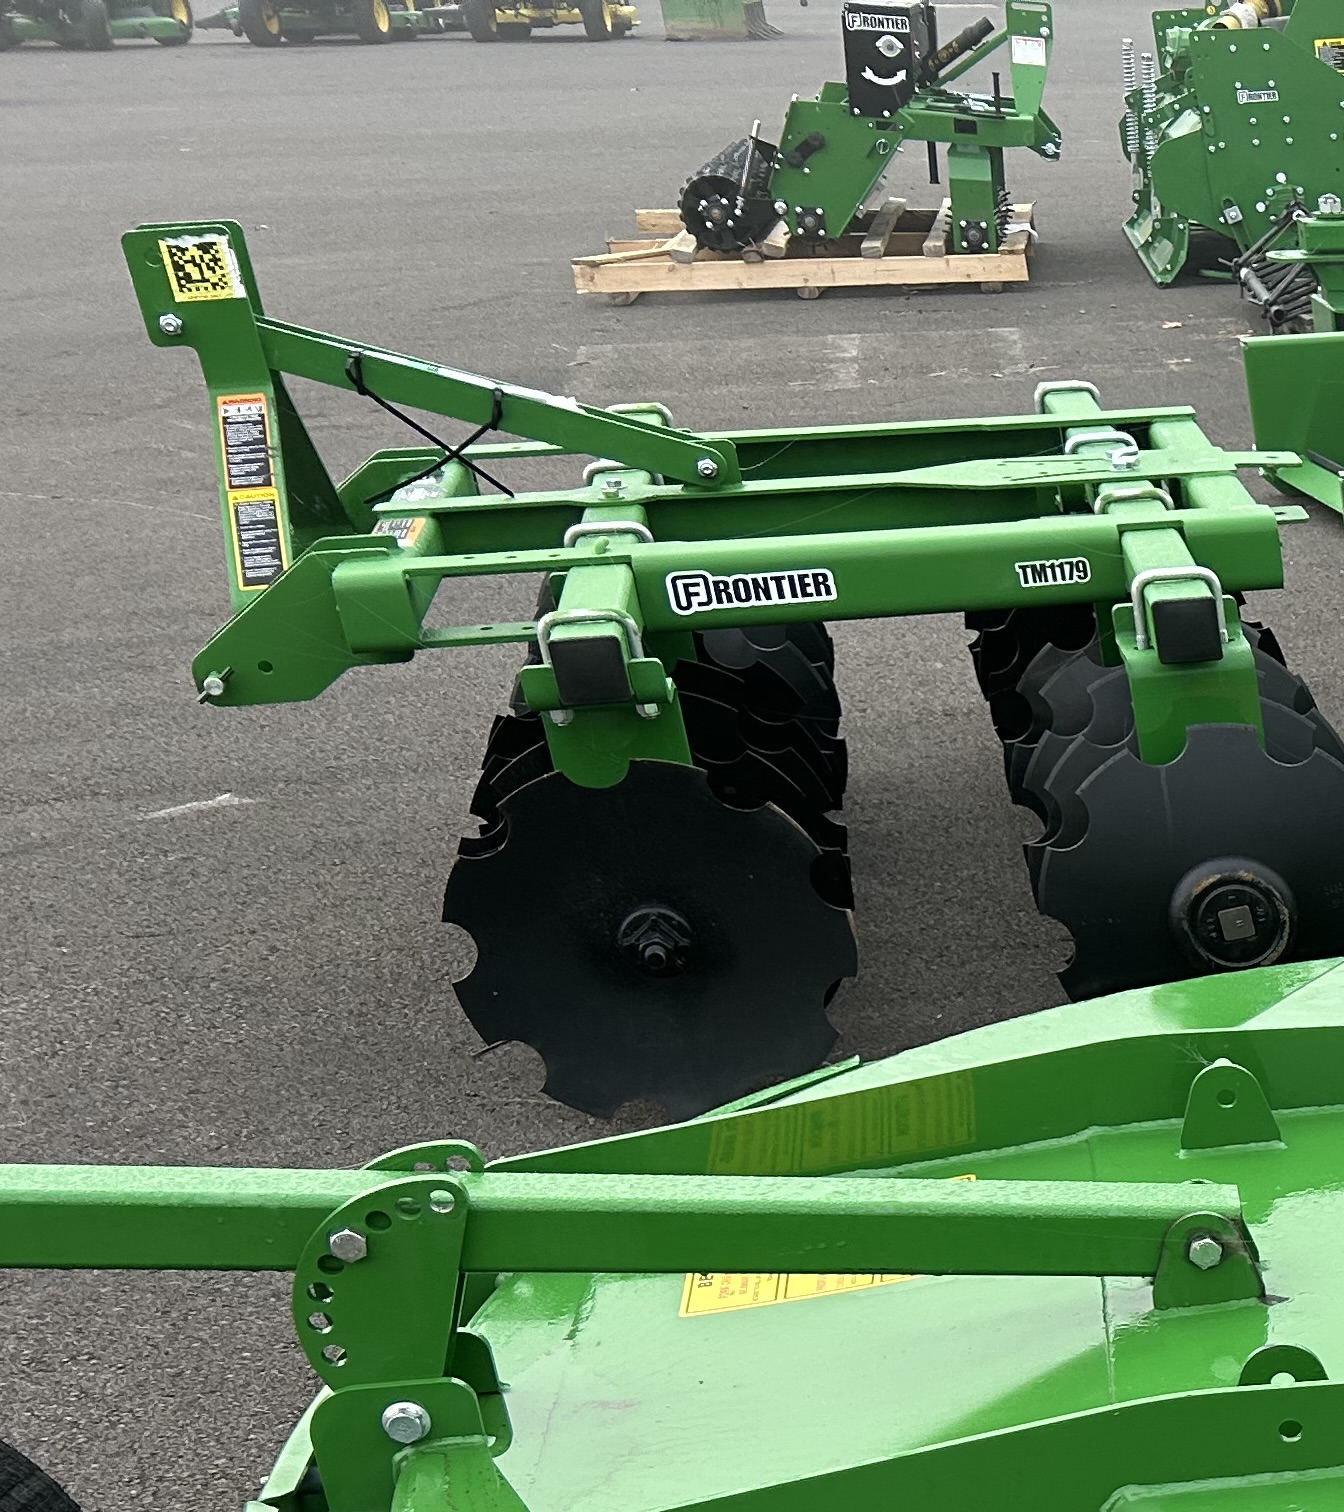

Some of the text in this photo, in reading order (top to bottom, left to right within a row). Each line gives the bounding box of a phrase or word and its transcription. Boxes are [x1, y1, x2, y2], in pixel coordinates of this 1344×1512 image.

[847, 13, 909, 31] FRONTIER
[1018, 559, 1089, 585] TM1179
[671, 572, 833, 612] FRONTIER
